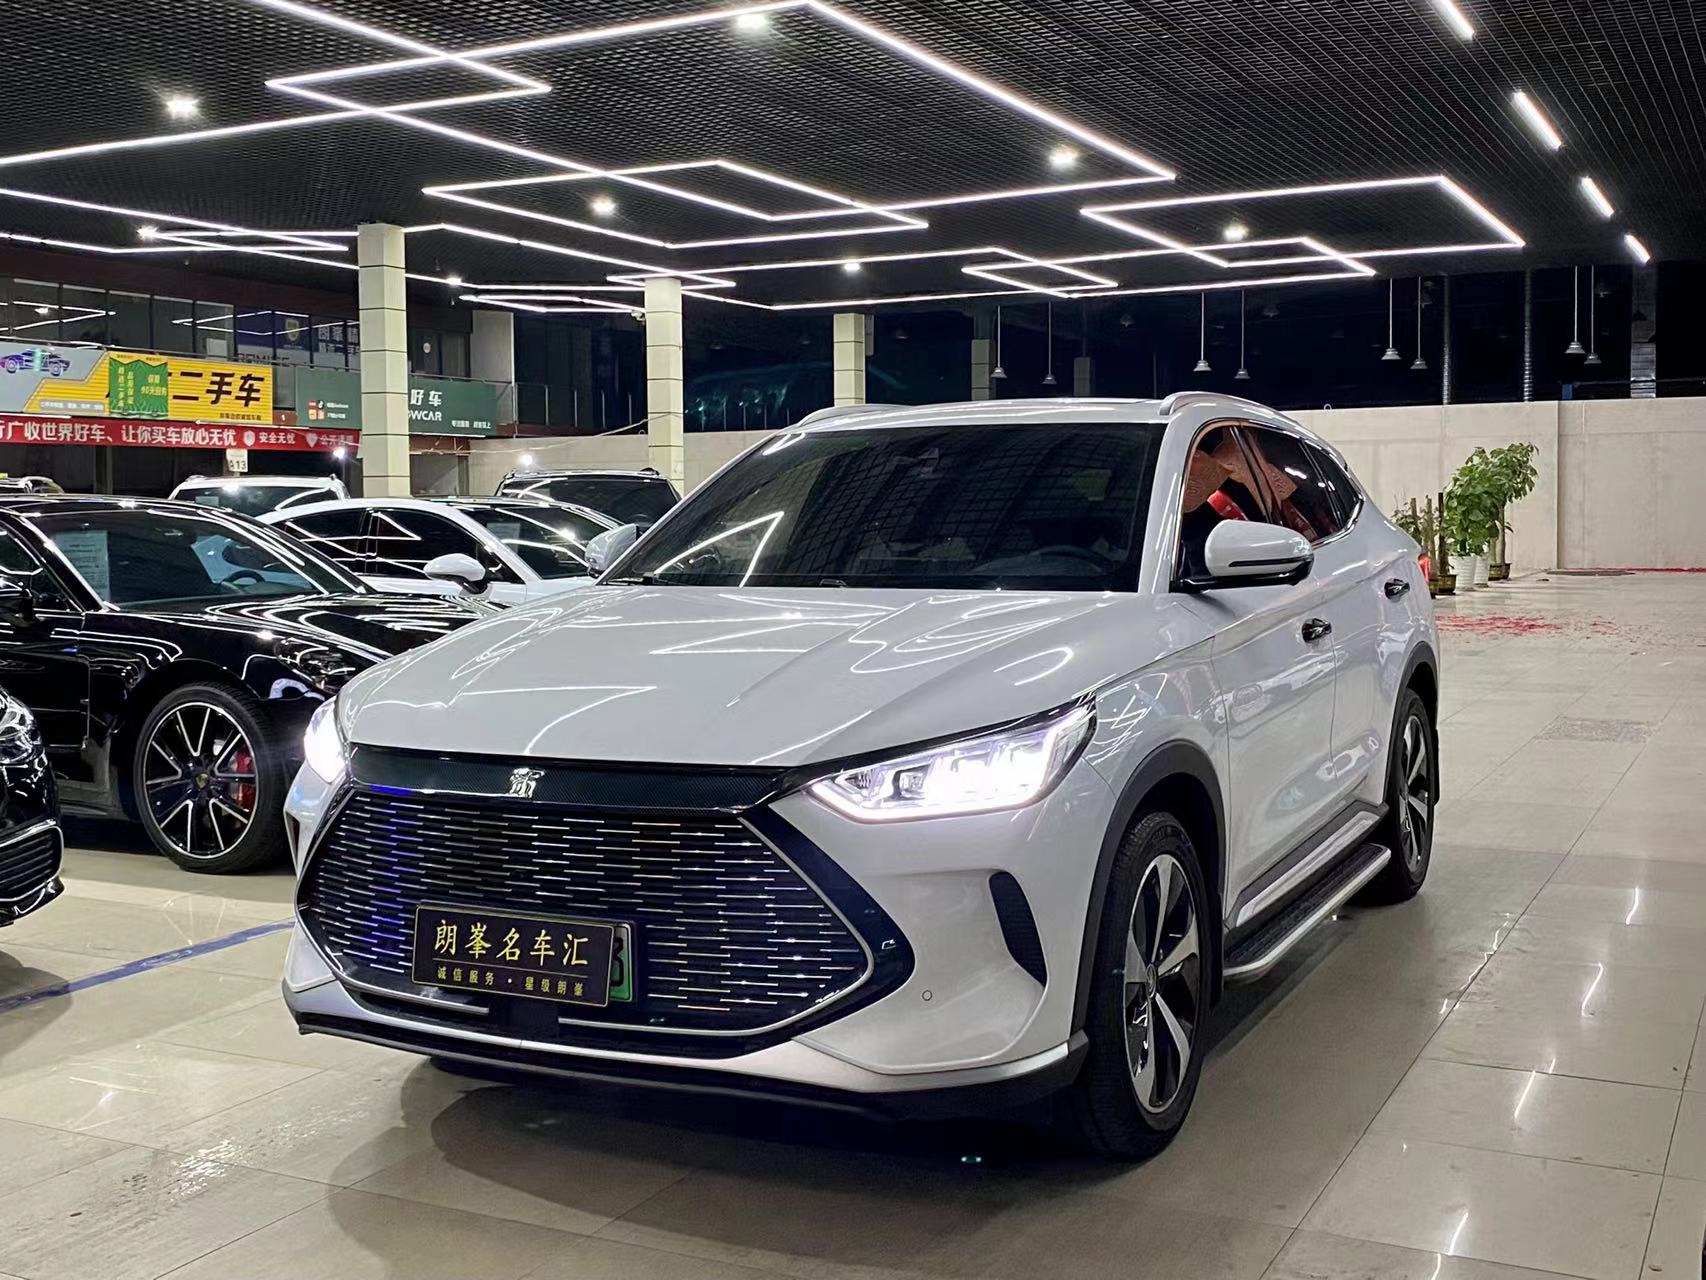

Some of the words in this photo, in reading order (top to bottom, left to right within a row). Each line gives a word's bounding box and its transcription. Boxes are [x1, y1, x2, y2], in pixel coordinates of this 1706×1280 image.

[410, 389, 443, 407] 好车
[258, 431, 295, 445] 安全无忧
[434, 919, 589, 967] 朗峯名车汇
